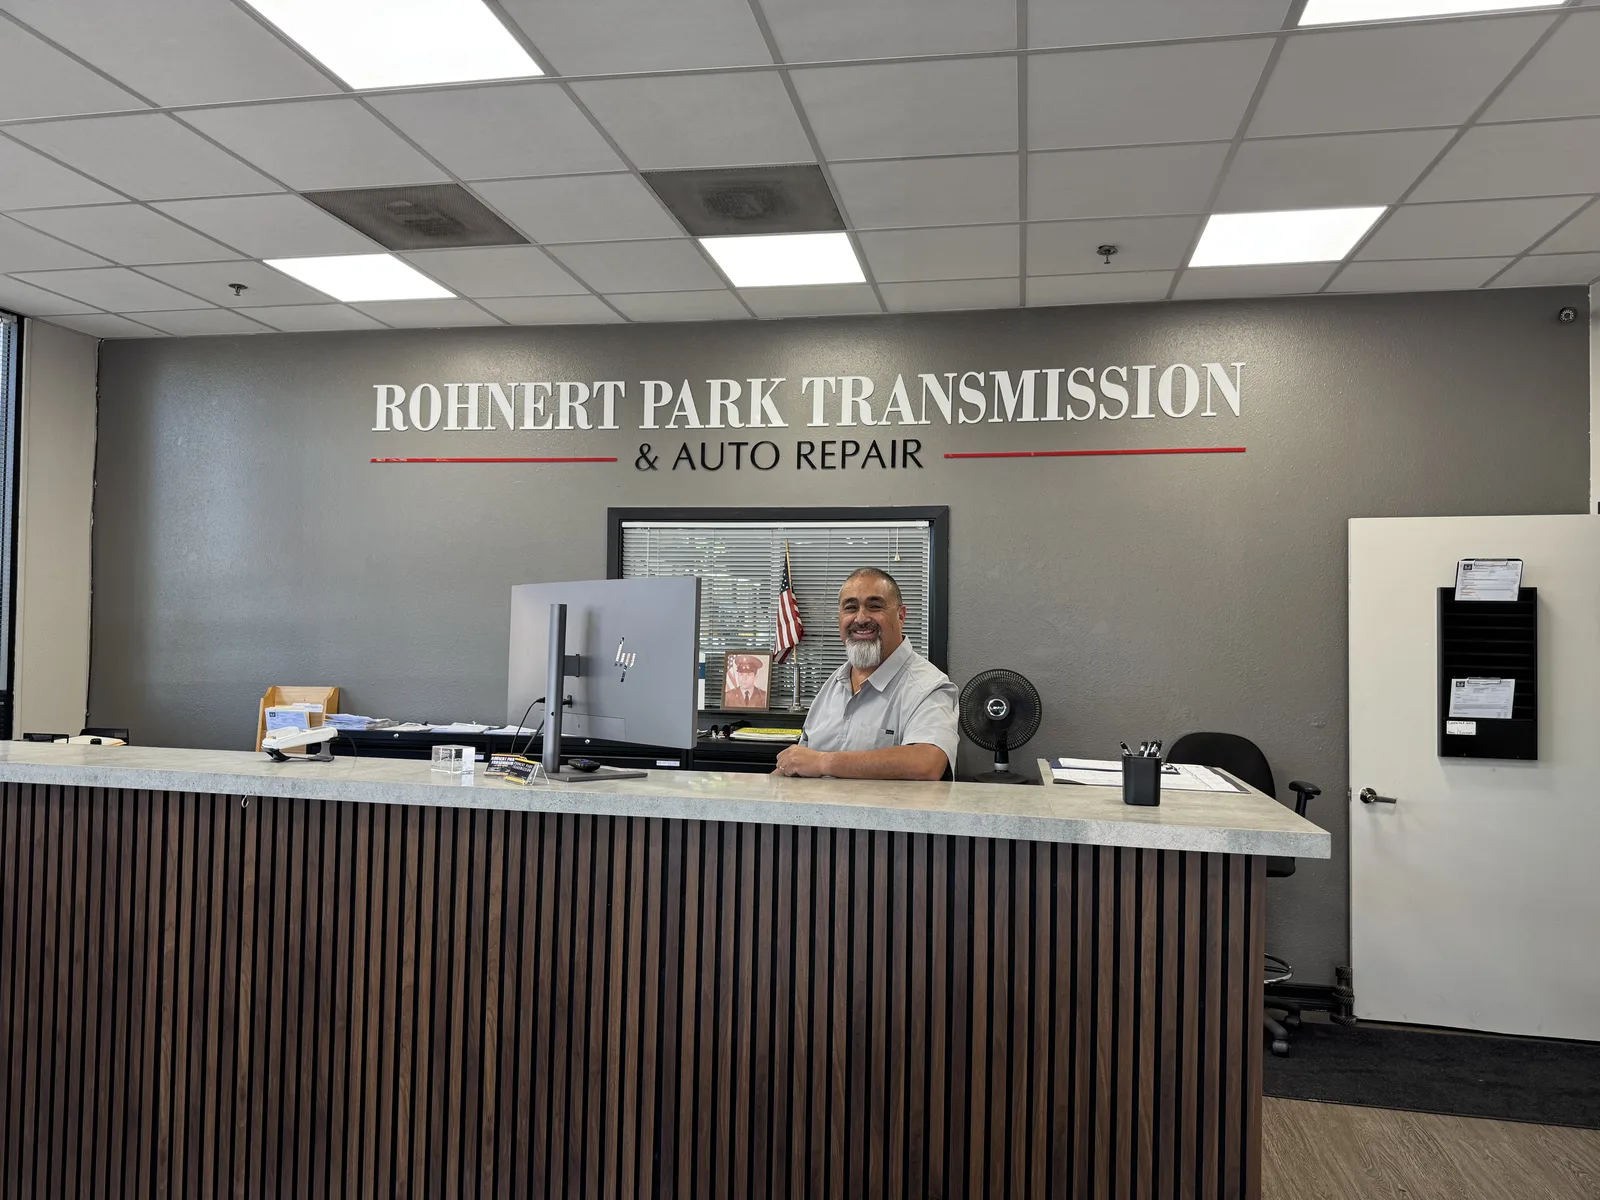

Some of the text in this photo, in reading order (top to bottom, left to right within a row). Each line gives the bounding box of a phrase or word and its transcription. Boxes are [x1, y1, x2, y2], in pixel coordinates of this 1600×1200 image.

[371, 361, 1247, 432] ROHNERT PARK TRANSMISSION
[634, 439, 924, 471] & AUTO REPAIR
